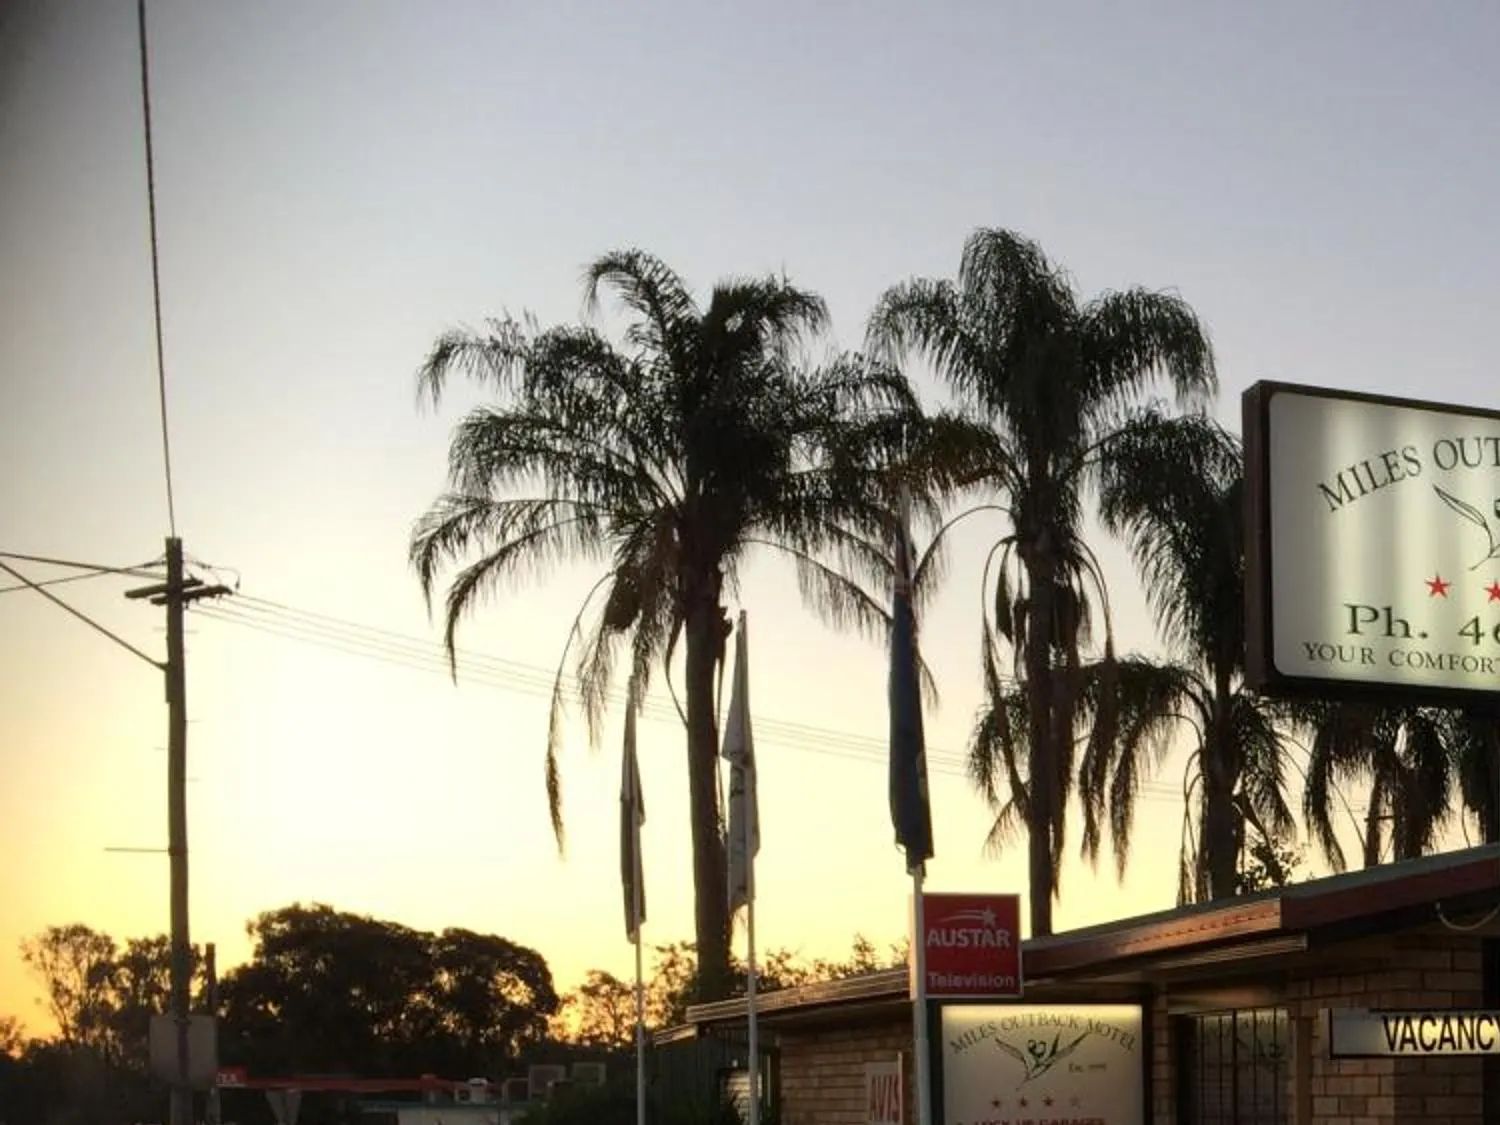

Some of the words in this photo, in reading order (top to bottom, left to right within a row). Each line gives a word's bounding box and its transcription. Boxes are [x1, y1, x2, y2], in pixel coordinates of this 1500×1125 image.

[1316, 445, 1422, 513] MILES
[1343, 603, 1429, 640] Ph.
[1302, 641, 1377, 667] YOUR
[926, 928, 1012, 948] AUSTAR
[928, 971, 1015, 988] Television
[949, 1022, 998, 1054] MILES
[1001, 1012, 1080, 1031] OUTBACK
[1087, 1017, 1138, 1052] MOTEL
